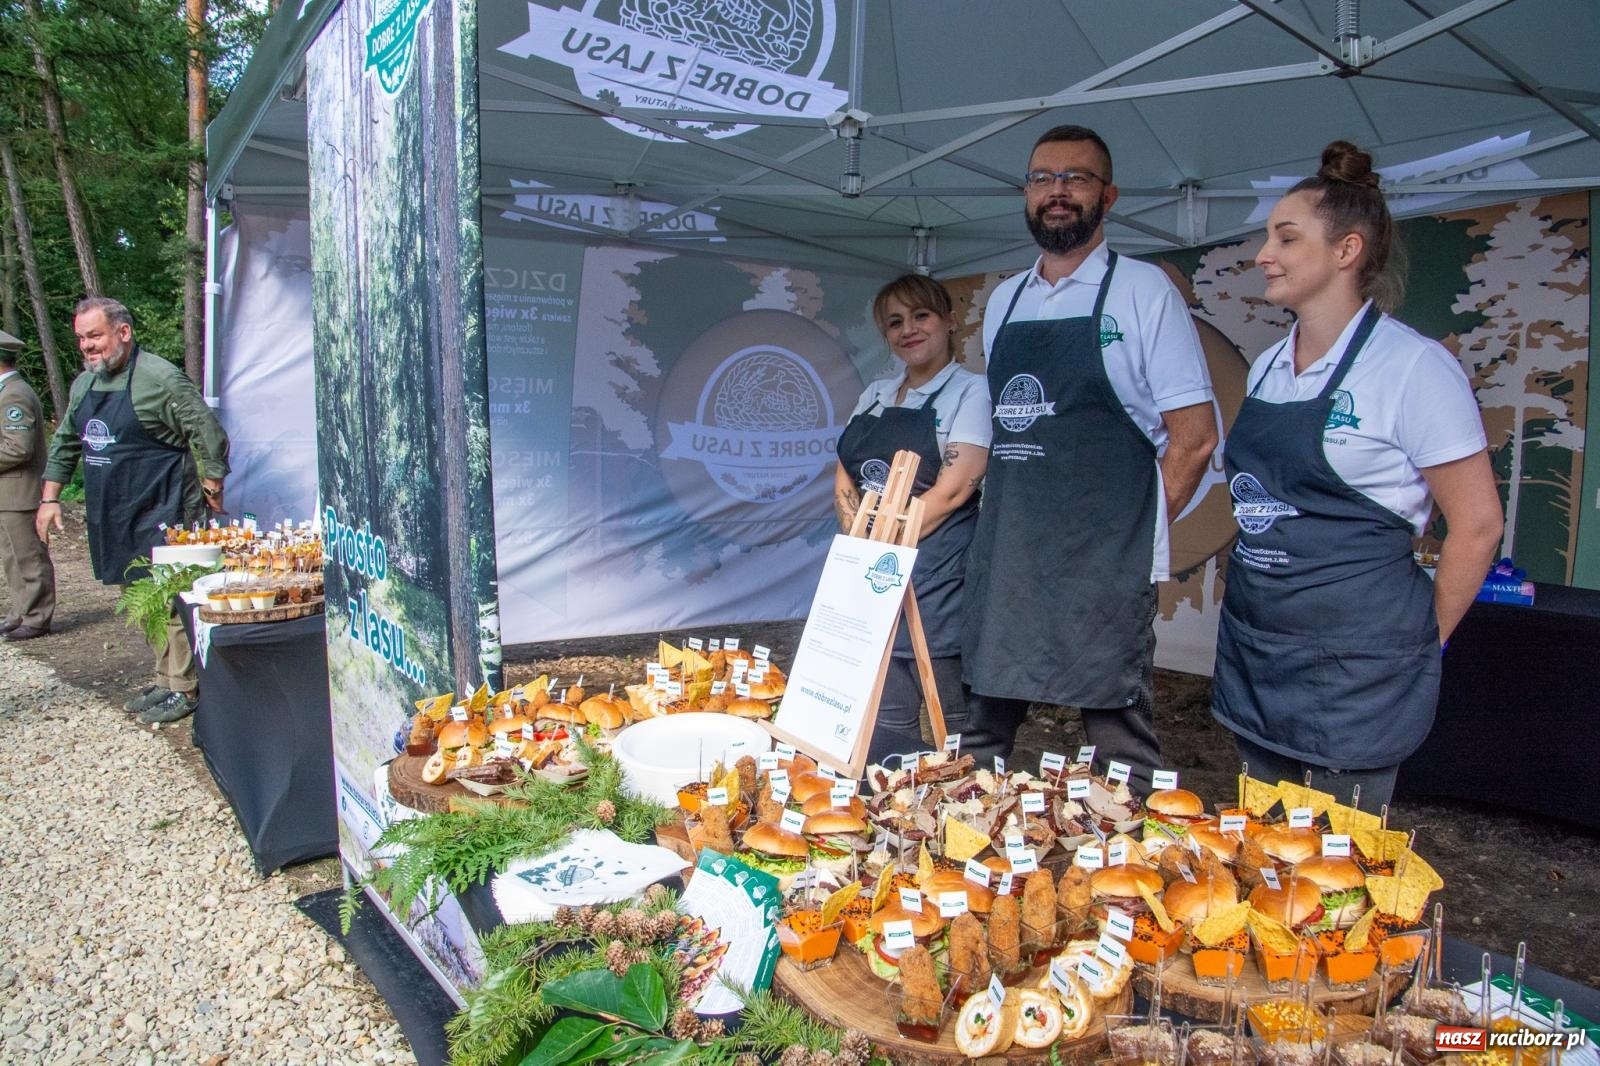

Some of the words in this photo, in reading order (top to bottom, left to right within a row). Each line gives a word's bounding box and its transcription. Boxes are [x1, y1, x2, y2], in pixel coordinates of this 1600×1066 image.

[372, 21, 395, 57] DOBRE
[396, 14, 401, 37] Z
[1025, 405, 1047, 414] LASU
[1266, 503, 1290, 513] LASU
[326, 504, 388, 582] Prosto
[348, 597, 360, 641] z
[360, 587, 427, 688] lasu...
